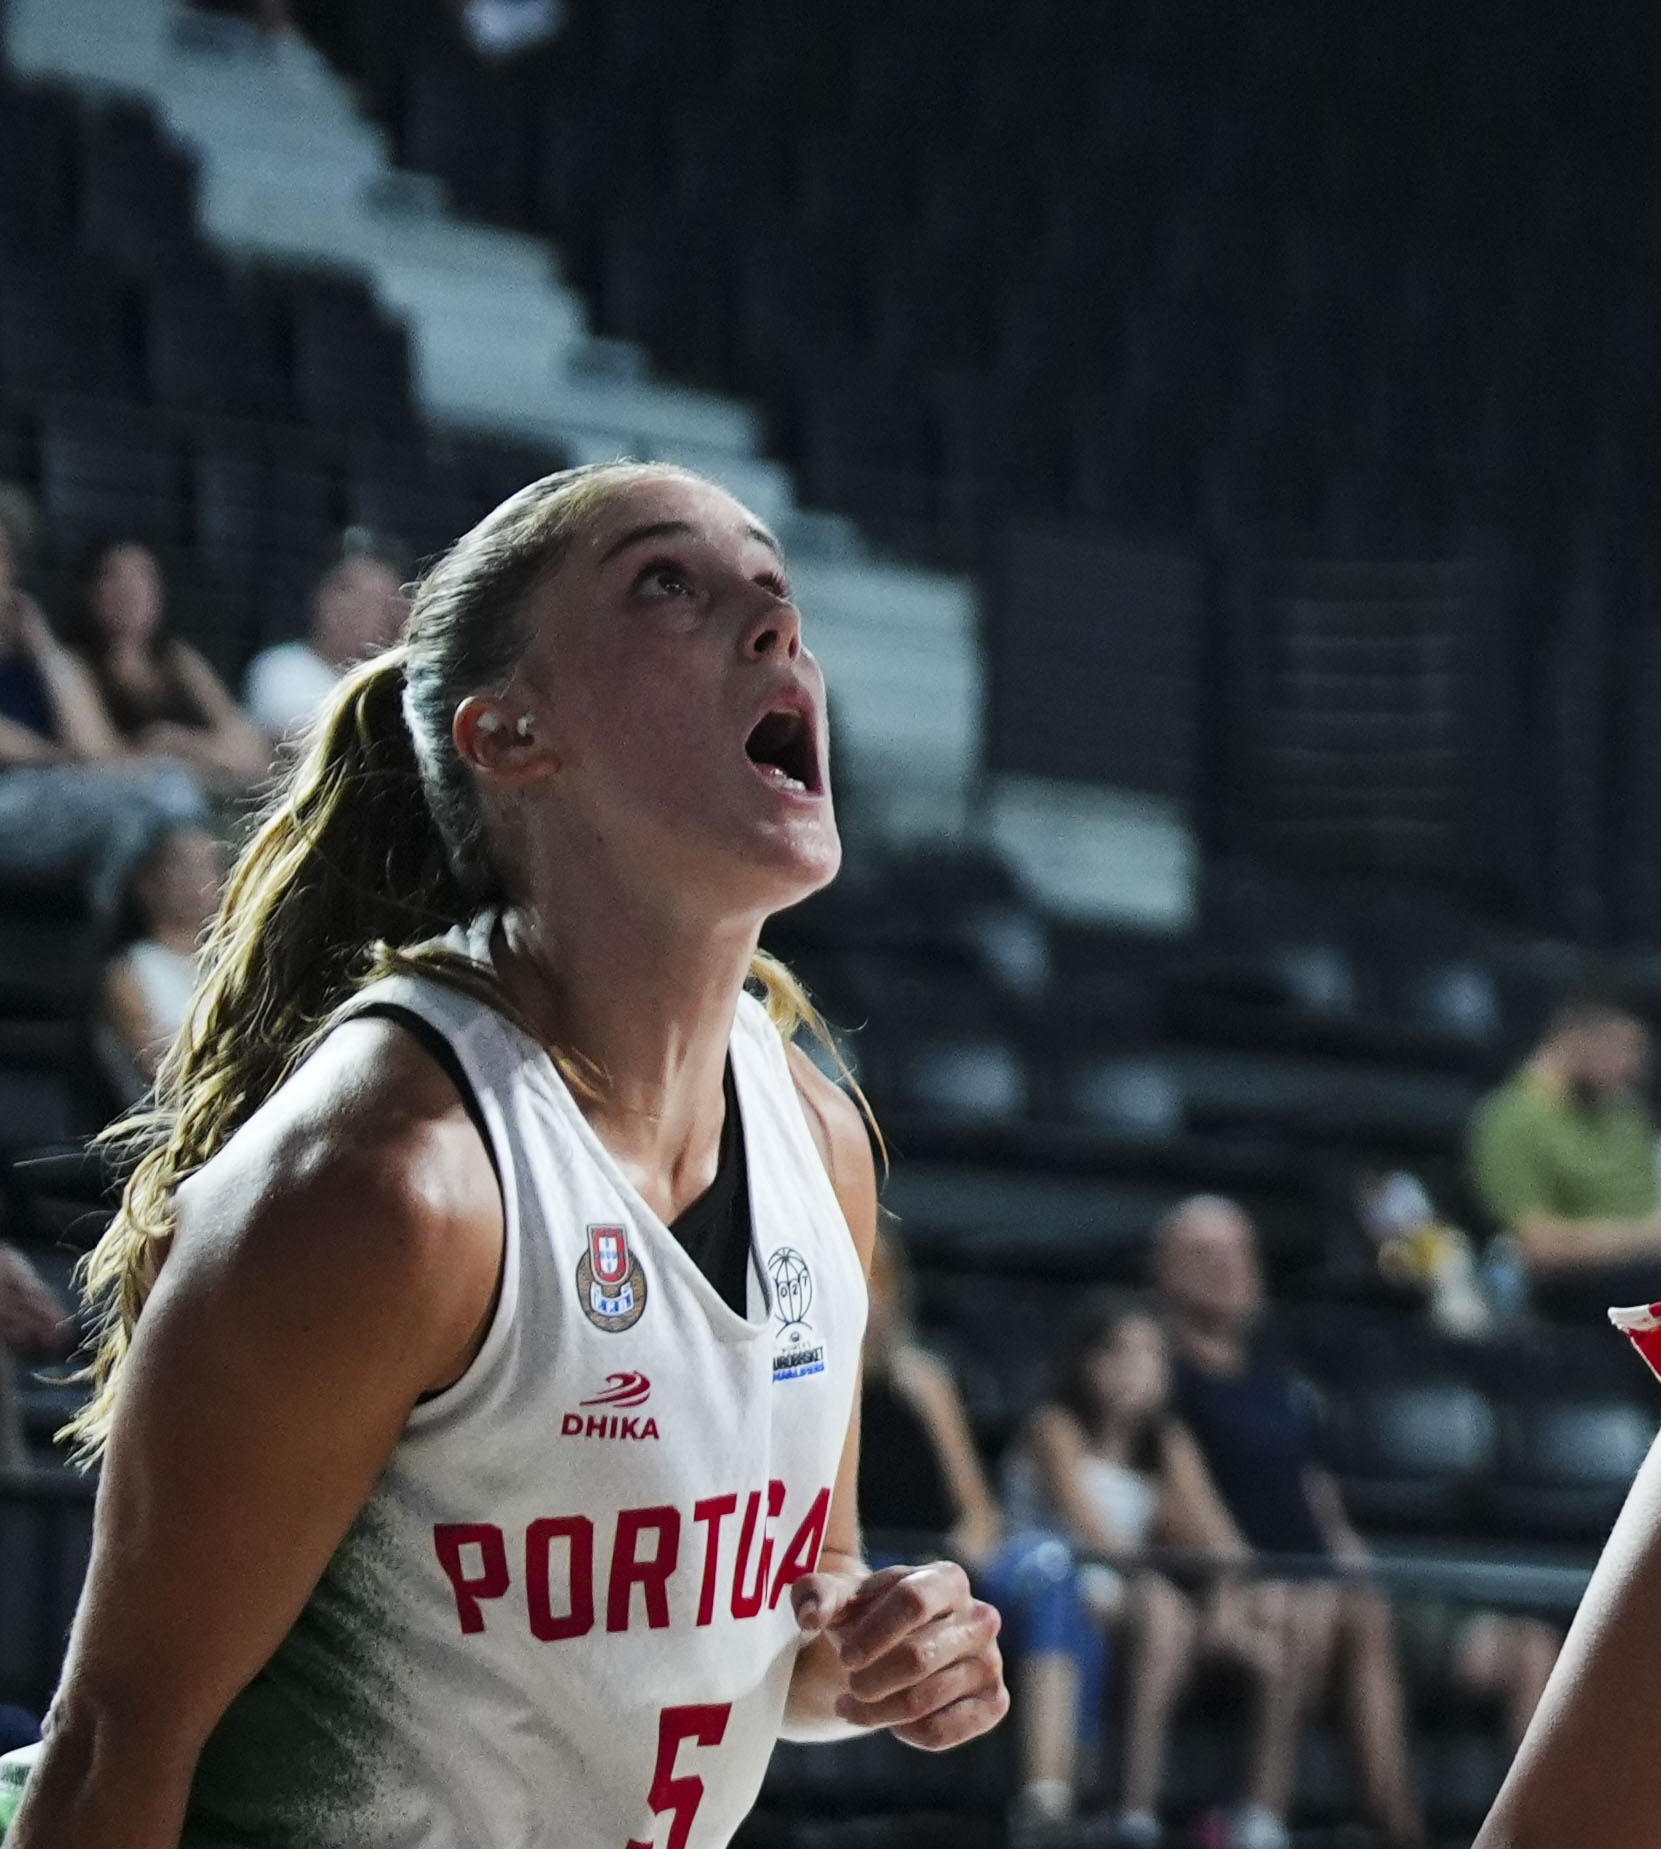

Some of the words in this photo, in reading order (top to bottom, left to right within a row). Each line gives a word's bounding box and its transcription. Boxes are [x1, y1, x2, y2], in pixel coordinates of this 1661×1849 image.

[561, 1413, 660, 1441] DHIKA
[433, 1479, 831, 1643] PORTUA
[624, 1701, 733, 1849] 5
